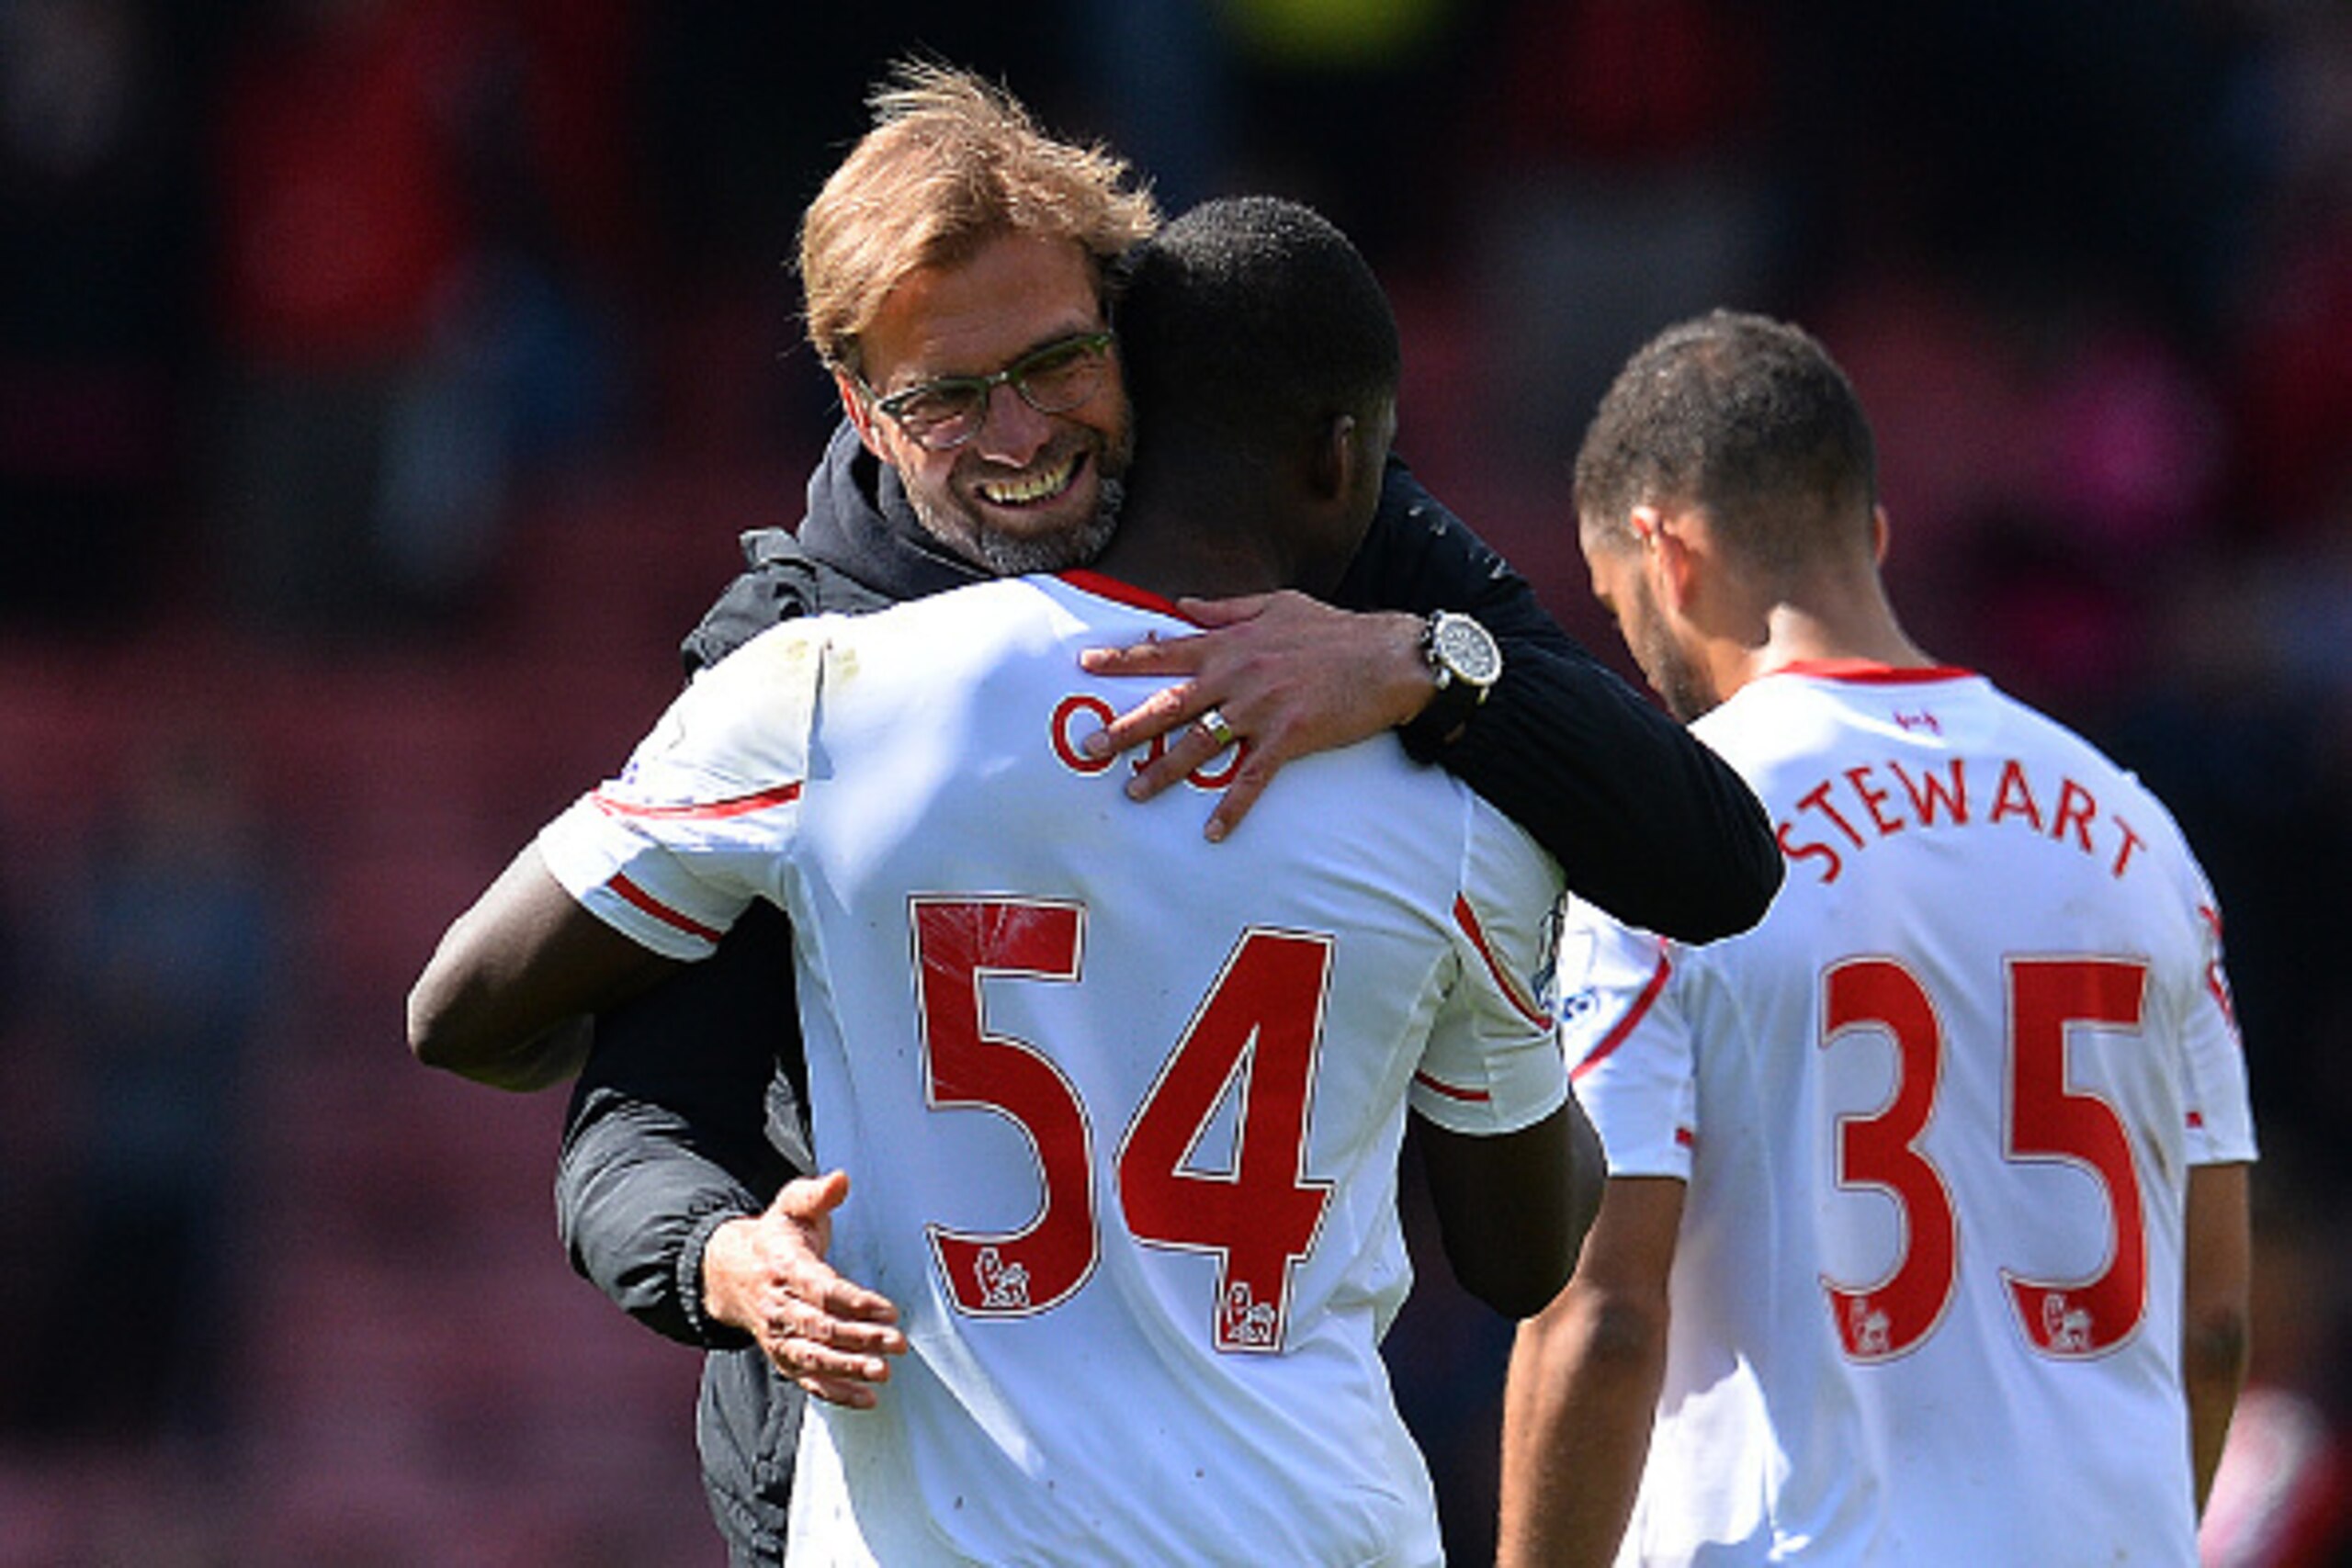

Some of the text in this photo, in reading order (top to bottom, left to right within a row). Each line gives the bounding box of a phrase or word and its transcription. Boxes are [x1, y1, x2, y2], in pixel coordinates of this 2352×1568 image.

[1777, 757, 2147, 884] STEWART
[909, 896, 1335, 1356] 54
[1820, 954, 2151, 1365] 35
